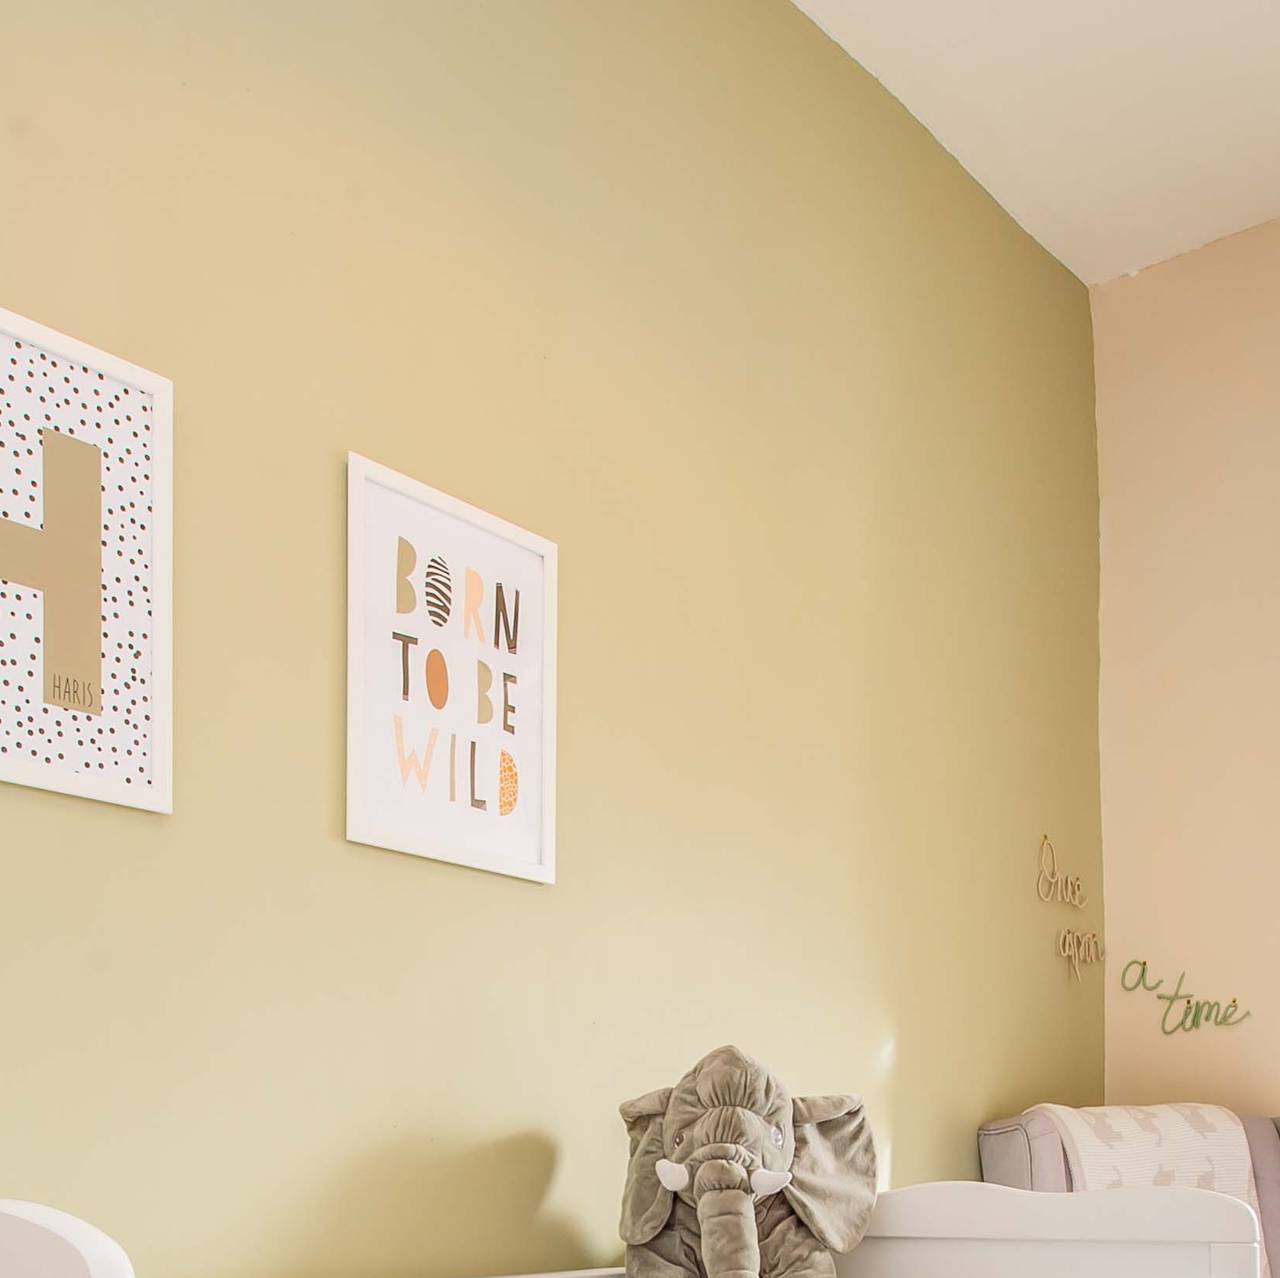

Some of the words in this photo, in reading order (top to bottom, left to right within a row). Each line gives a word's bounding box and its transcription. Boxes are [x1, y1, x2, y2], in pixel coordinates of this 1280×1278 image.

[396, 535, 520, 656] BORN
[52, 672, 94, 708] HARIS
[391, 631, 449, 711] TO
[476, 659, 518, 736] BE
[392, 713, 520, 817] WILD
[1120, 960, 1164, 992] a
[1156, 971, 1251, 1036] time
